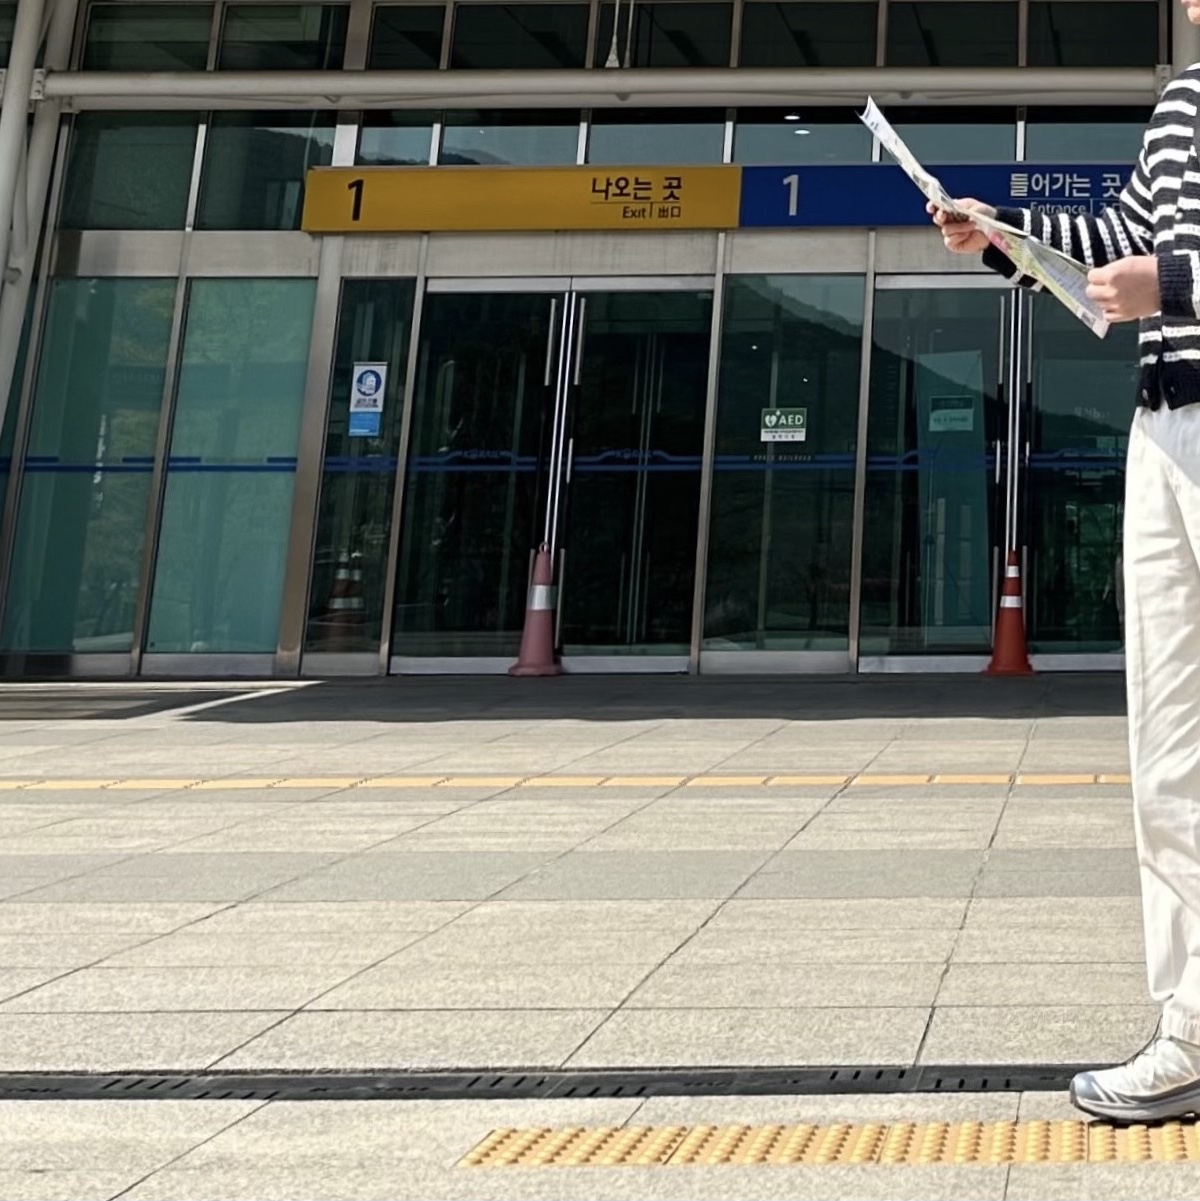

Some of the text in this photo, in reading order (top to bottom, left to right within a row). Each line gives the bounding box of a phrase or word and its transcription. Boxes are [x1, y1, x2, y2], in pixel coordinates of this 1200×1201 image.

[591, 176, 682, 201] 나오는 곳
[782, 174, 799, 216] 1
[1010, 173, 1121, 198] 들어가는 곳
[347, 178, 364, 221] 1
[622, 205, 646, 219] Exit
[658, 205, 681, 218] 出口
[778, 414, 804, 425] AED
